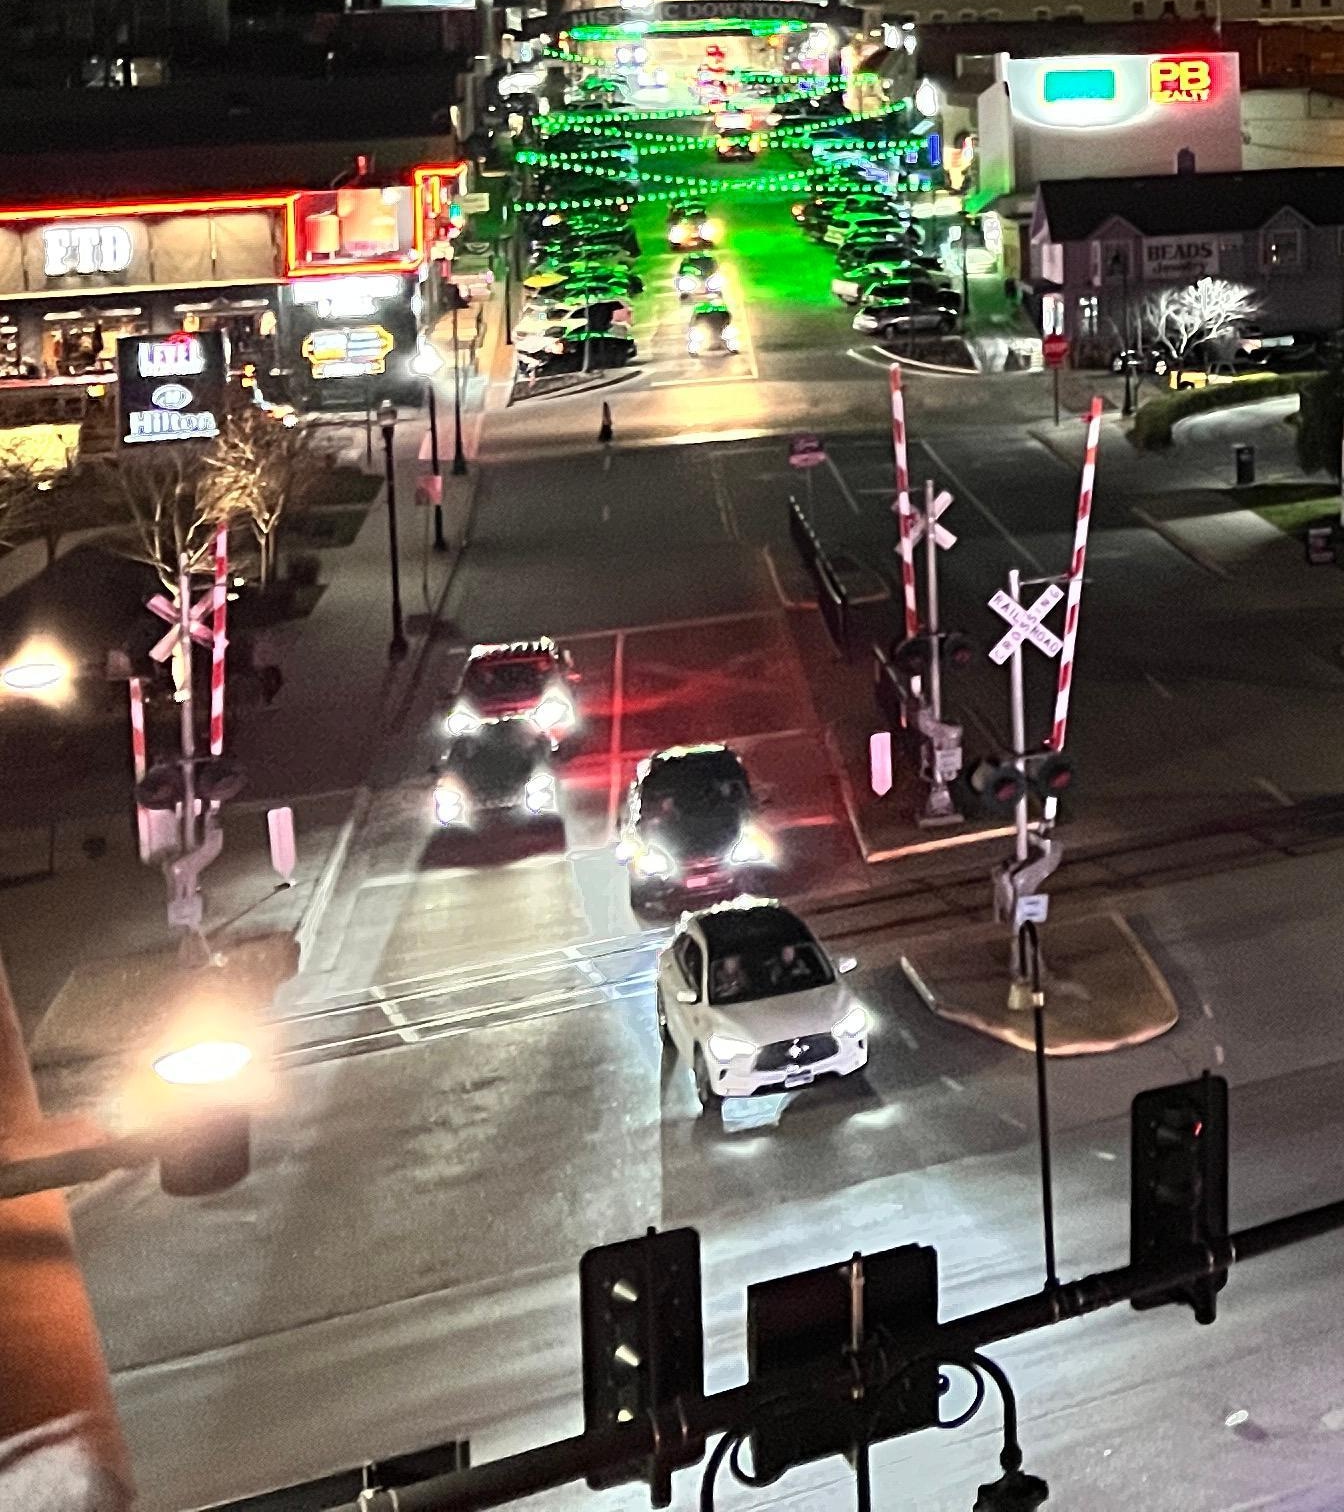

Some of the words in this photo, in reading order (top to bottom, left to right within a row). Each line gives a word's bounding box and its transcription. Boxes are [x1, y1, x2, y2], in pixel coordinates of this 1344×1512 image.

[686, 2, 817, 19] DOWNTOWN
[1151, 61, 1211, 91] PB
[1147, 243, 1212, 262] BEADS
[130, 410, 216, 434] Hilton
